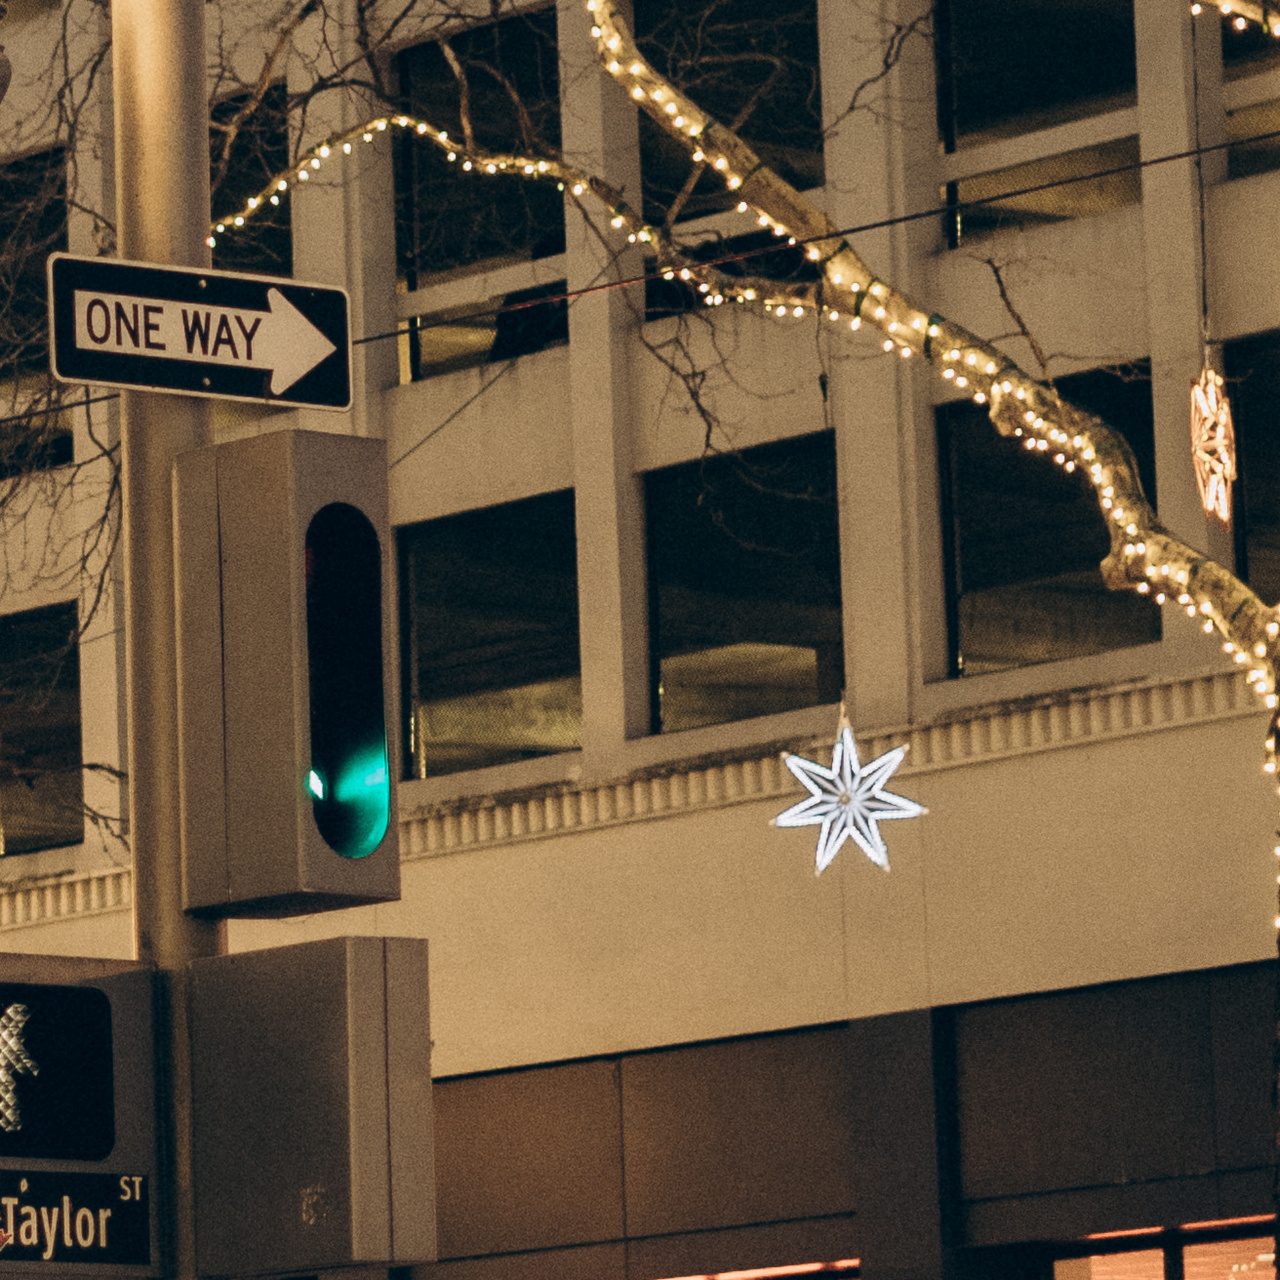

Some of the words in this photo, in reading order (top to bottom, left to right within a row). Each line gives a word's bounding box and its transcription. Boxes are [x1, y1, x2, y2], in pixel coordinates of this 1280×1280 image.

[86, 298, 167, 352] ONE
[181, 308, 263, 361] WAY
[1, 1195, 112, 1261] Taylor
[120, 1176, 143, 1201] ST
